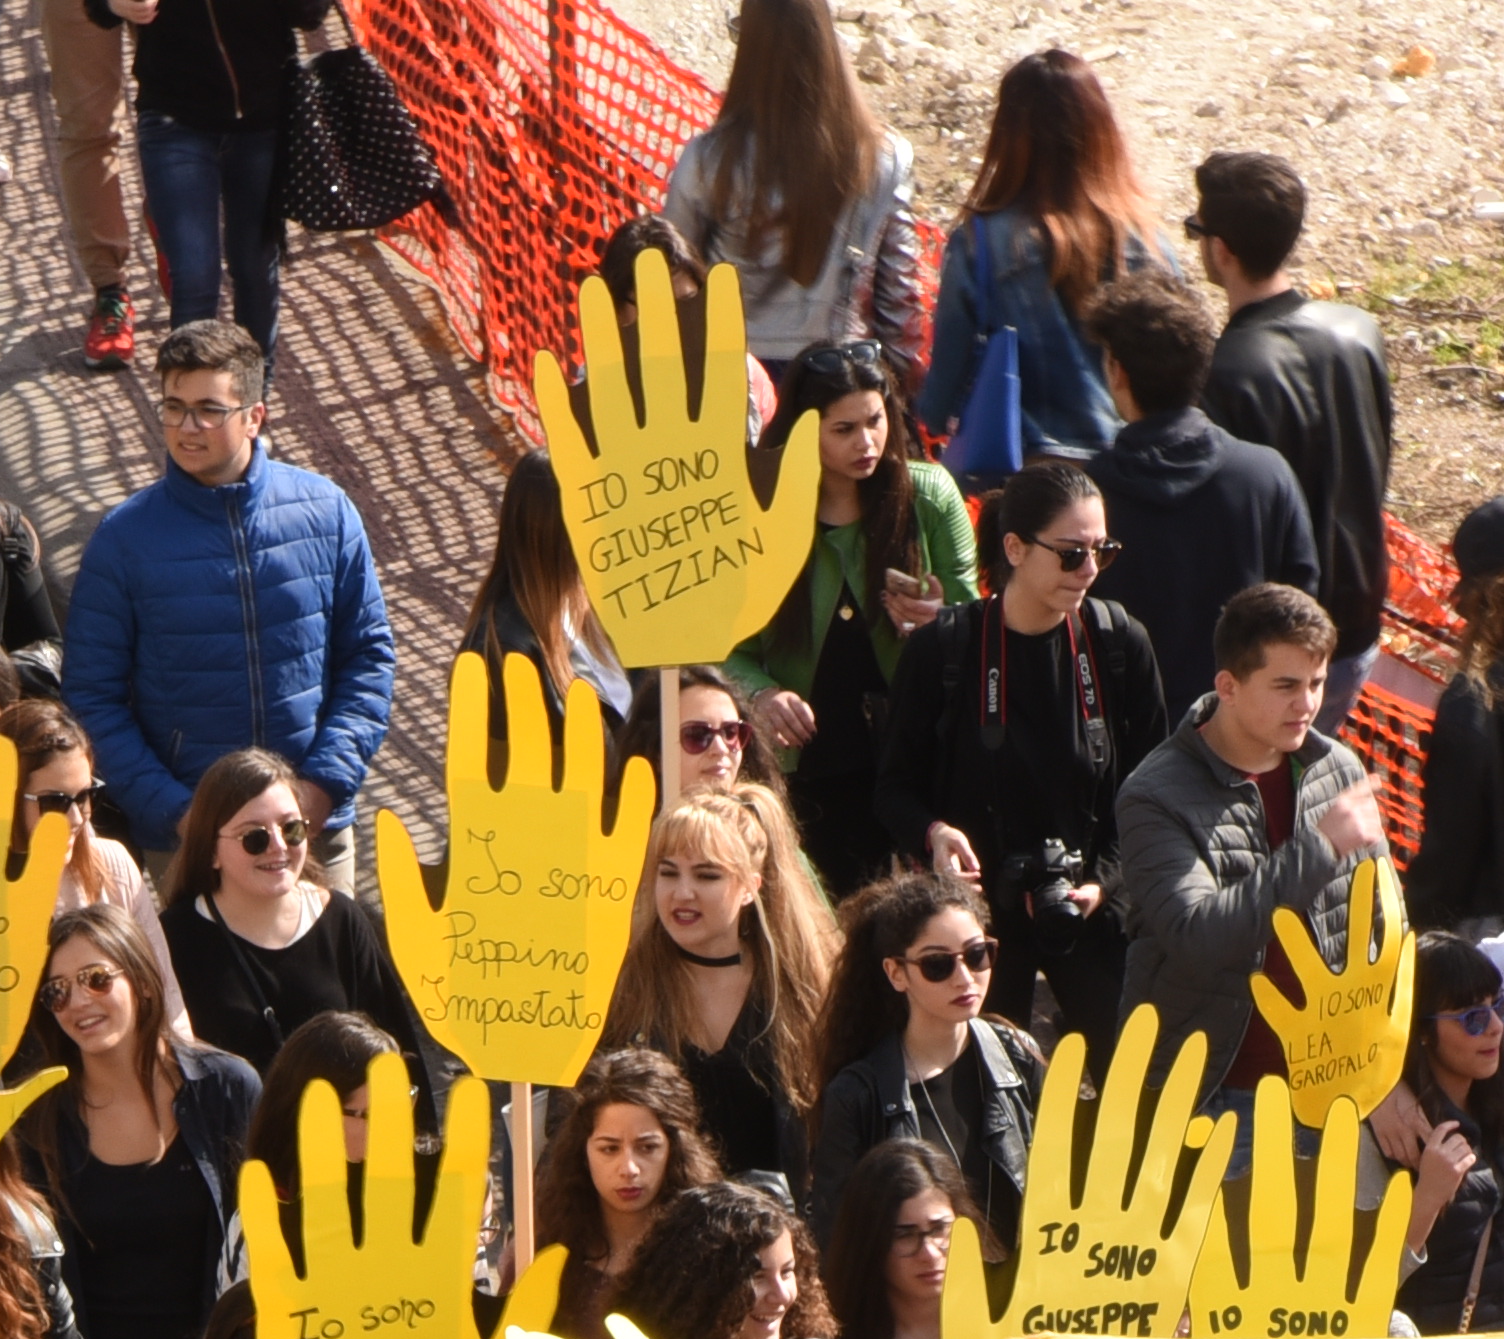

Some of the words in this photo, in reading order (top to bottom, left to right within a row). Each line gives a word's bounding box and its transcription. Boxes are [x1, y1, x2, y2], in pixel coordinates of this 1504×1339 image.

[578, 474, 626, 523] IO
[643, 450, 719, 496] SONO
[589, 492, 740, 573] GIUSEPPE
[603, 527, 765, 619] TIZIAN
[989, 669, 1000, 712] Canon
[468, 830, 521, 894] Io
[540, 868, 626, 900] sono
[443, 910, 589, 978] Peppino
[422, 975, 601, 1046] Impastato
[1319, 995, 1342, 1021] IO
[1344, 982, 1384, 1016] SONO
[1289, 1032, 1333, 1065] LEA
[1290, 1042, 1380, 1092] GAROFALO
[1039, 1222, 1079, 1256] IO
[1084, 1245, 1157, 1280] SONO
[362, 1296, 437, 1339] sono
[1023, 1303, 1158, 1337] GIUSEPPE
[1209, 1305, 1241, 1333] IO
[1267, 1308, 1348, 1339] SONO
